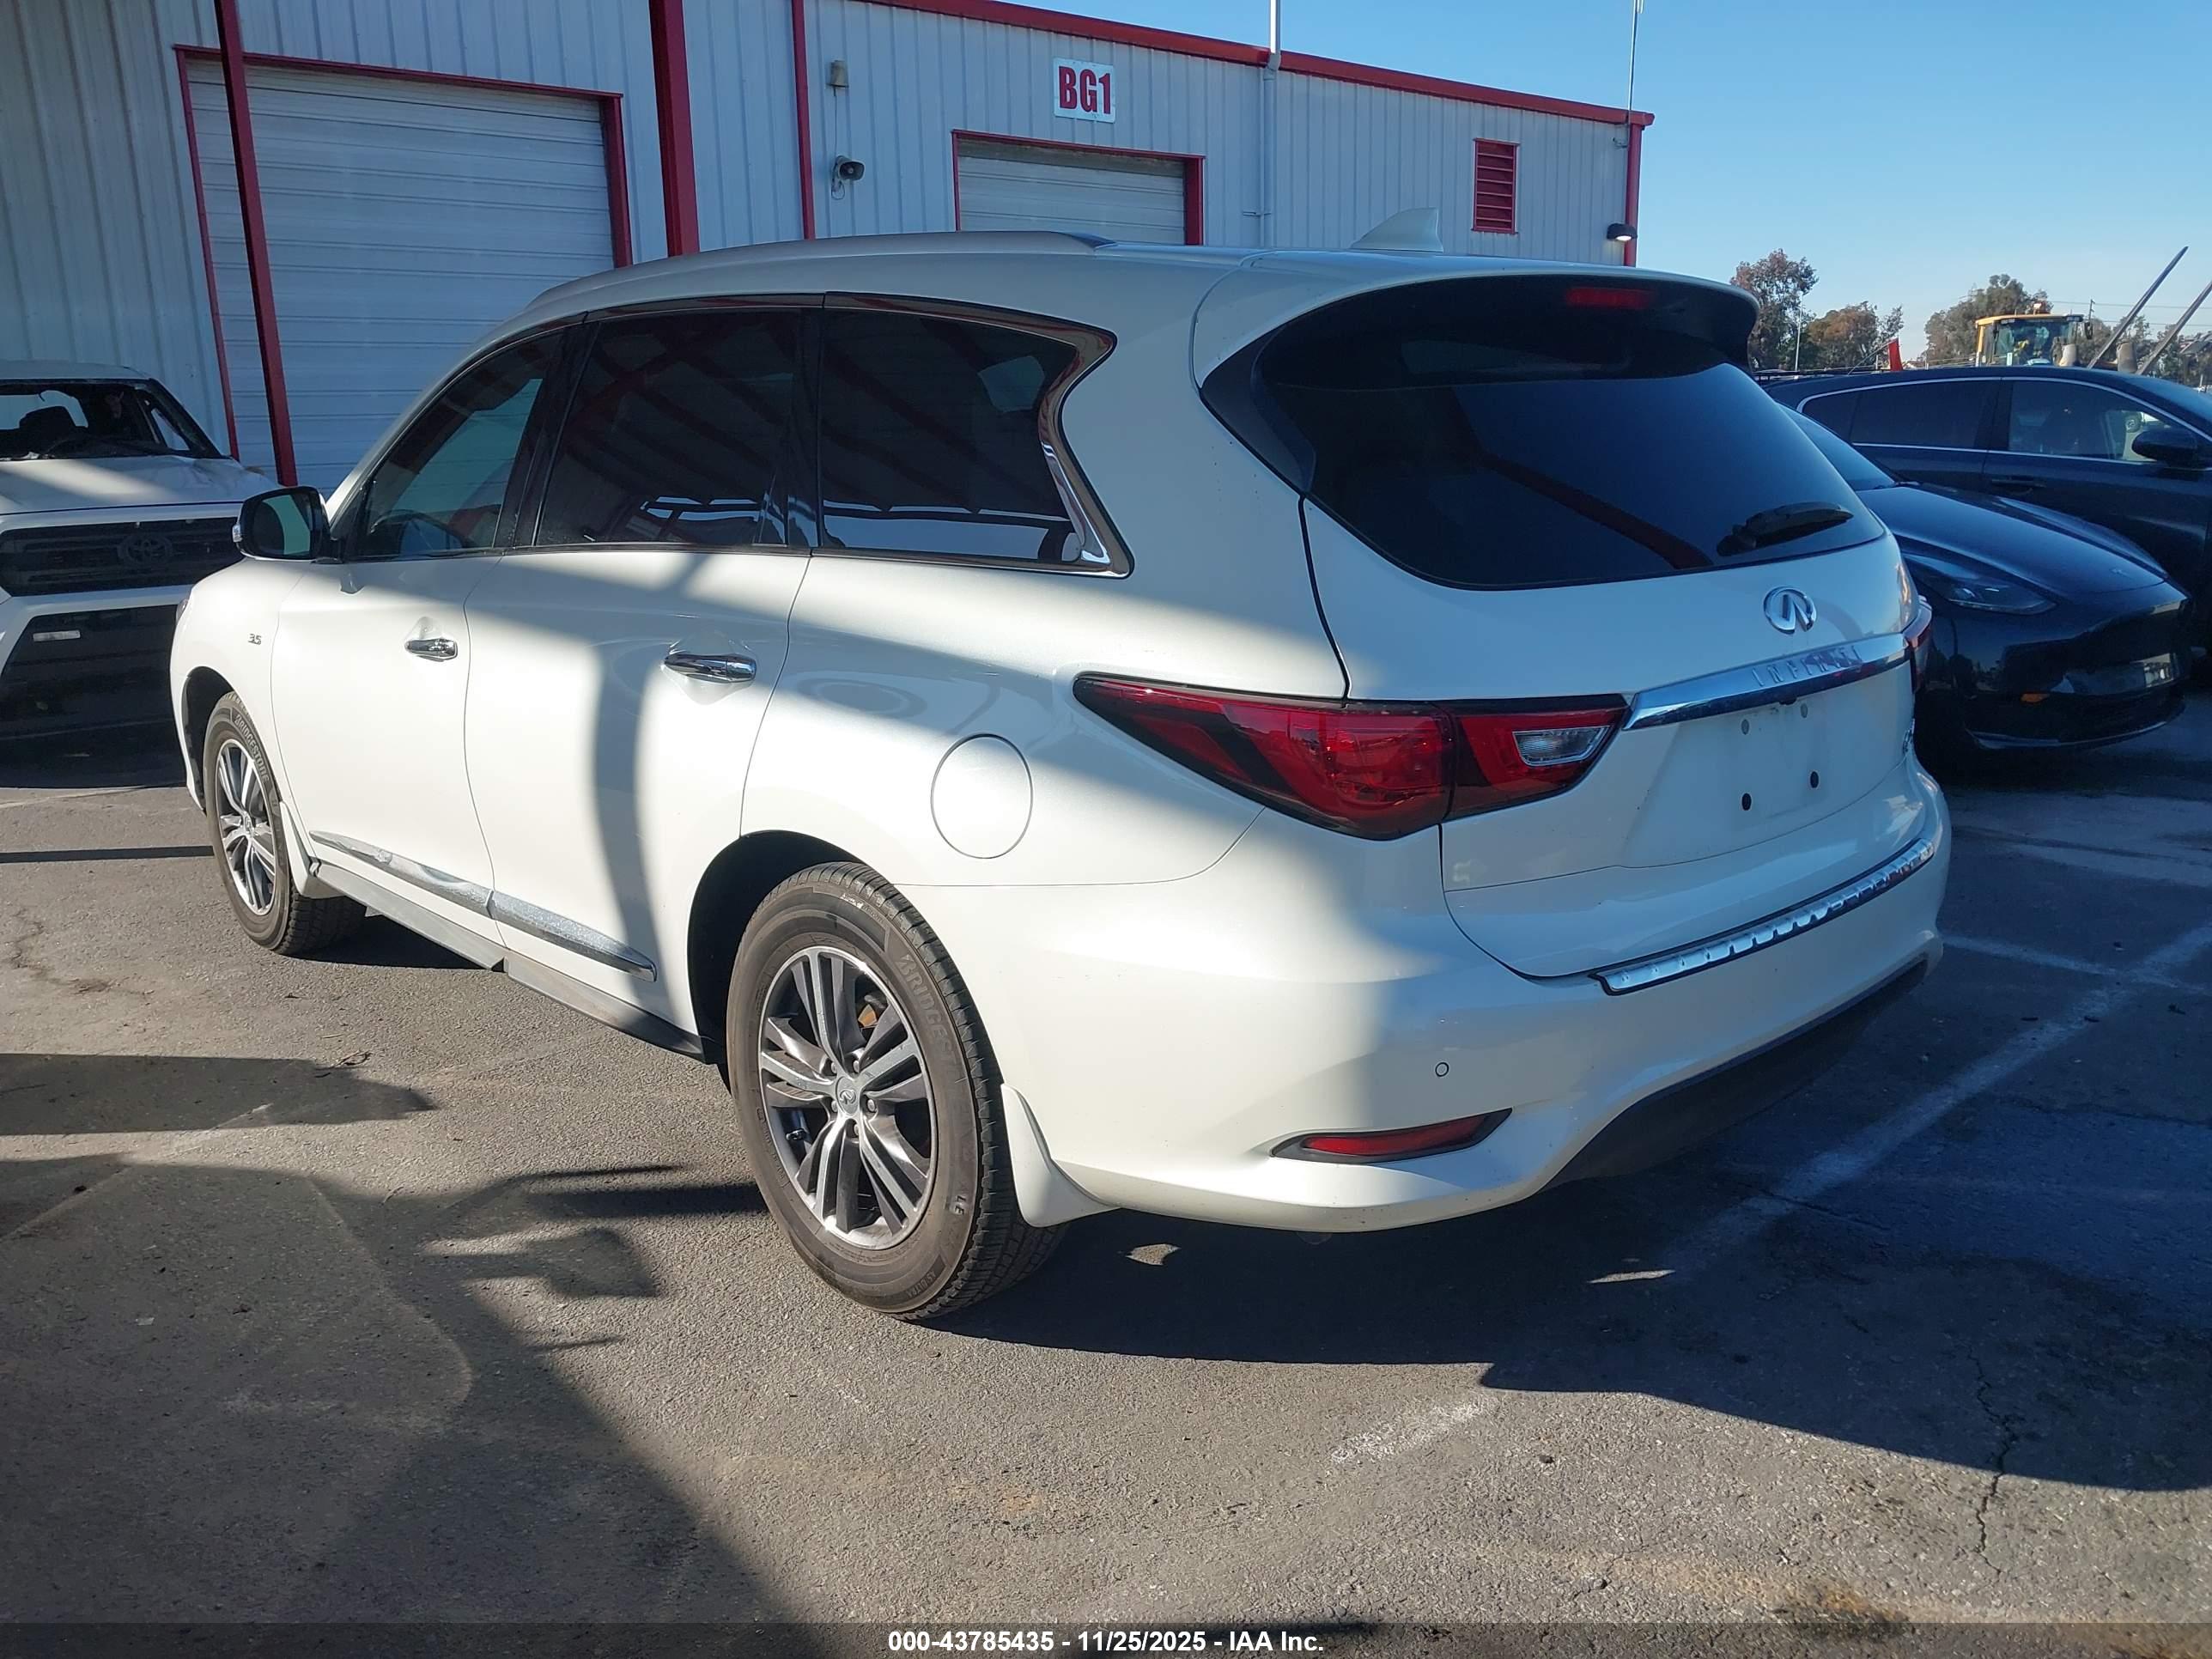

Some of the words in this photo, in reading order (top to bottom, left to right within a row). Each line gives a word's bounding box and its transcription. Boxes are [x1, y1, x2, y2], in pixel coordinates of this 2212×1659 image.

[1059, 65, 1111, 115] BG1
[1752, 645, 1863, 687] INFINITI
[234, 714, 270, 783] BRIDGESTONE
